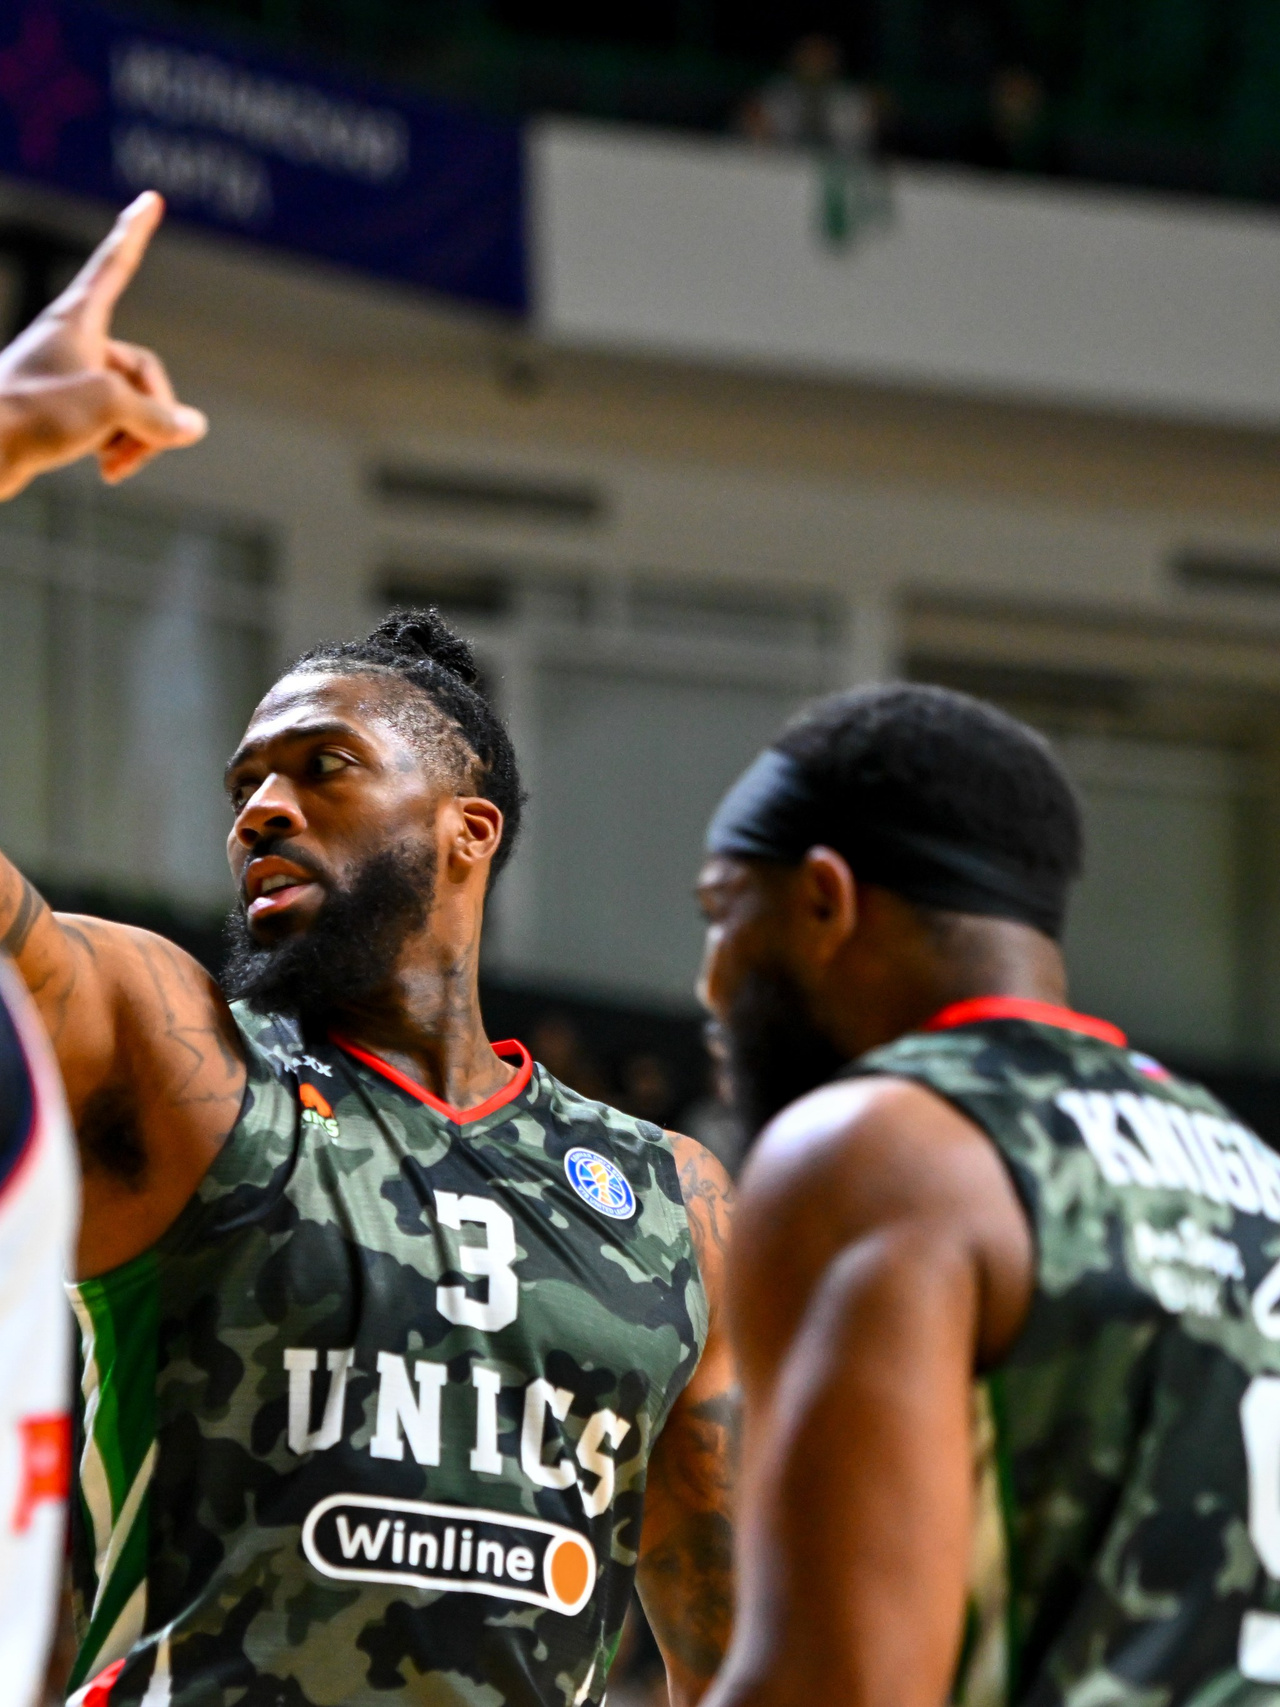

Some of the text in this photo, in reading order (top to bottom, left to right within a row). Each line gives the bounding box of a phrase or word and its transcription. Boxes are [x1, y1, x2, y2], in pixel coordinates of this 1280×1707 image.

[435, 1189, 518, 1332] 3
[283, 1348, 631, 1518] UNICS
[336, 1514, 536, 1582] Winline
